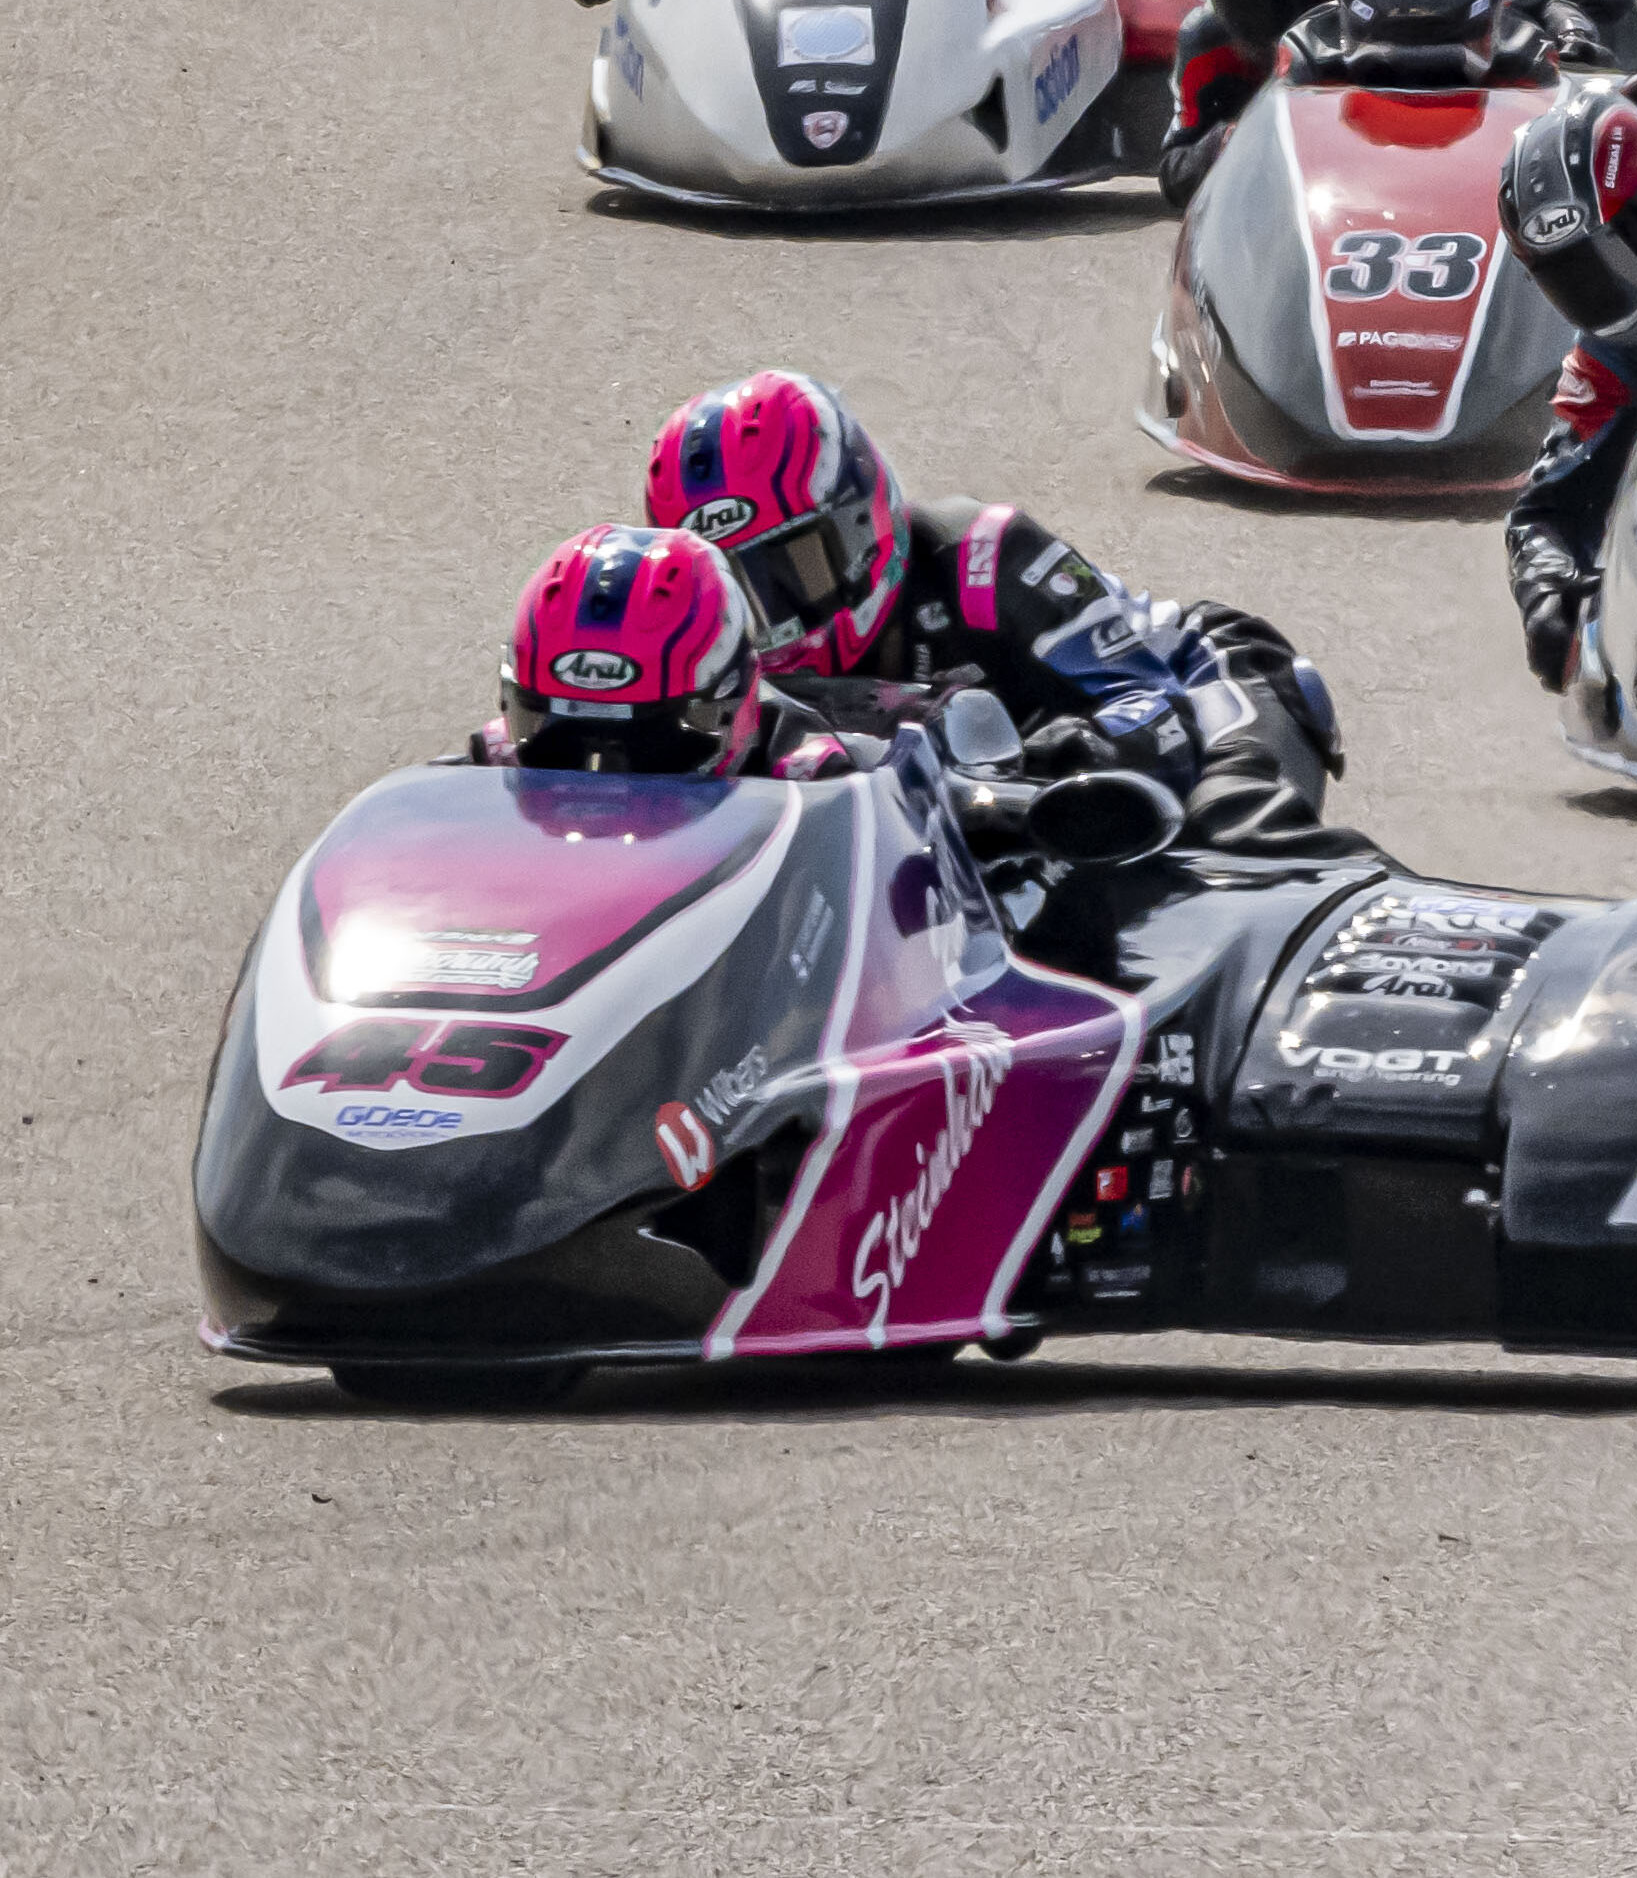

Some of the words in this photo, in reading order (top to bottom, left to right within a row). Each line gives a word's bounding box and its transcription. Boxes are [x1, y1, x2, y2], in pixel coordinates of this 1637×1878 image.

[1325, 230, 1487, 302] 33
[278, 1016, 573, 1099] 45
[1278, 1045, 1468, 1074] VOGT
